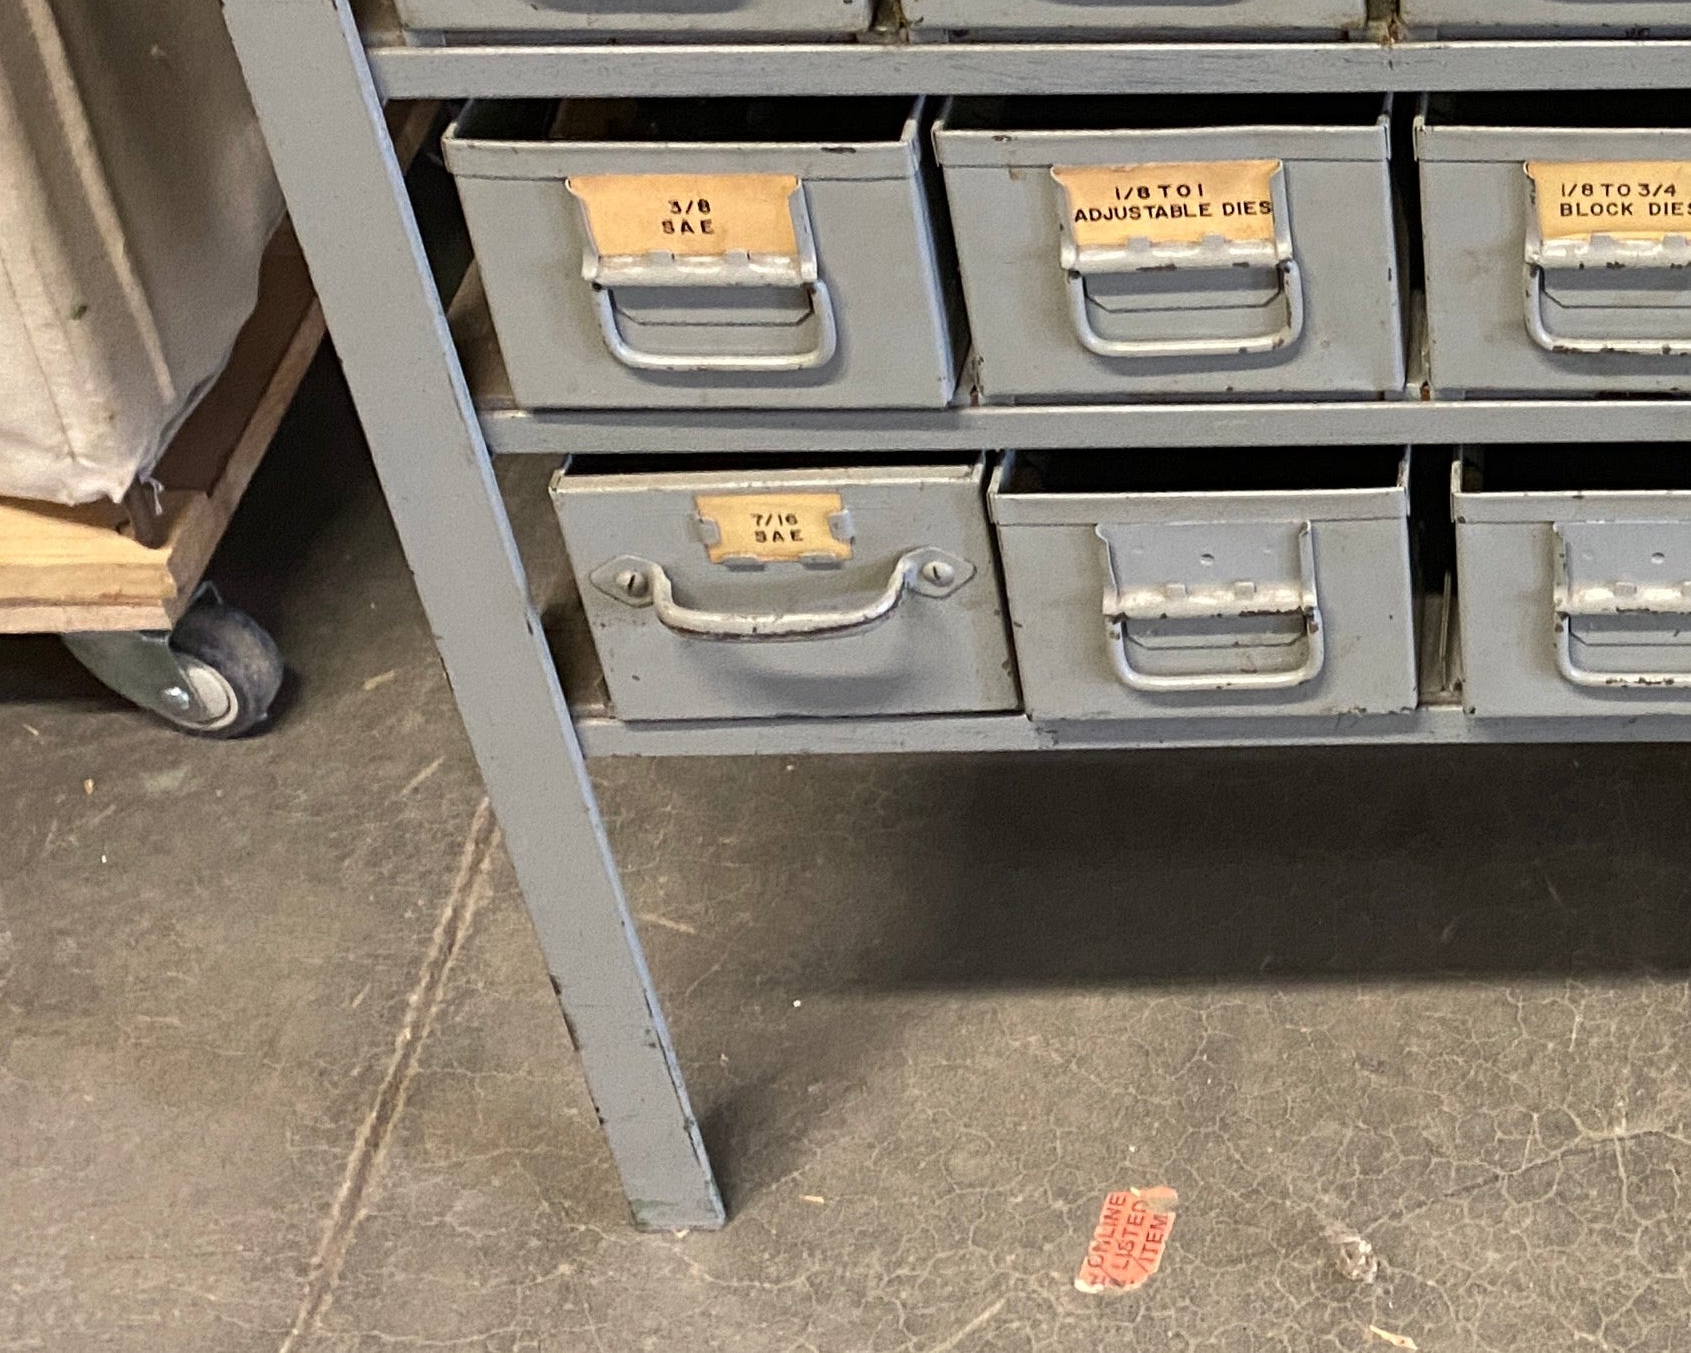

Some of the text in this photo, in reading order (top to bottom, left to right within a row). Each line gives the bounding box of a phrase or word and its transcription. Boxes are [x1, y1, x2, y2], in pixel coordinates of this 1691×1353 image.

[1115, 186, 1150, 201] 1/8
[1157, 184, 1191, 198] TO
[1562, 183, 1677, 197] 1/8 TO 3/4
[668, 198, 711, 215] 3/8
[1075, 200, 1272, 223] ADJUSTABLE DIES
[1560, 202, 1634, 217] BLOCK
[662, 219, 715, 235] SAE
[752, 513, 798, 527] 7/16
[755, 529, 803, 542] SAE
[1088, 1194, 1126, 1267] ONLINE
[1139, 1214, 1168, 1262] ITEM
